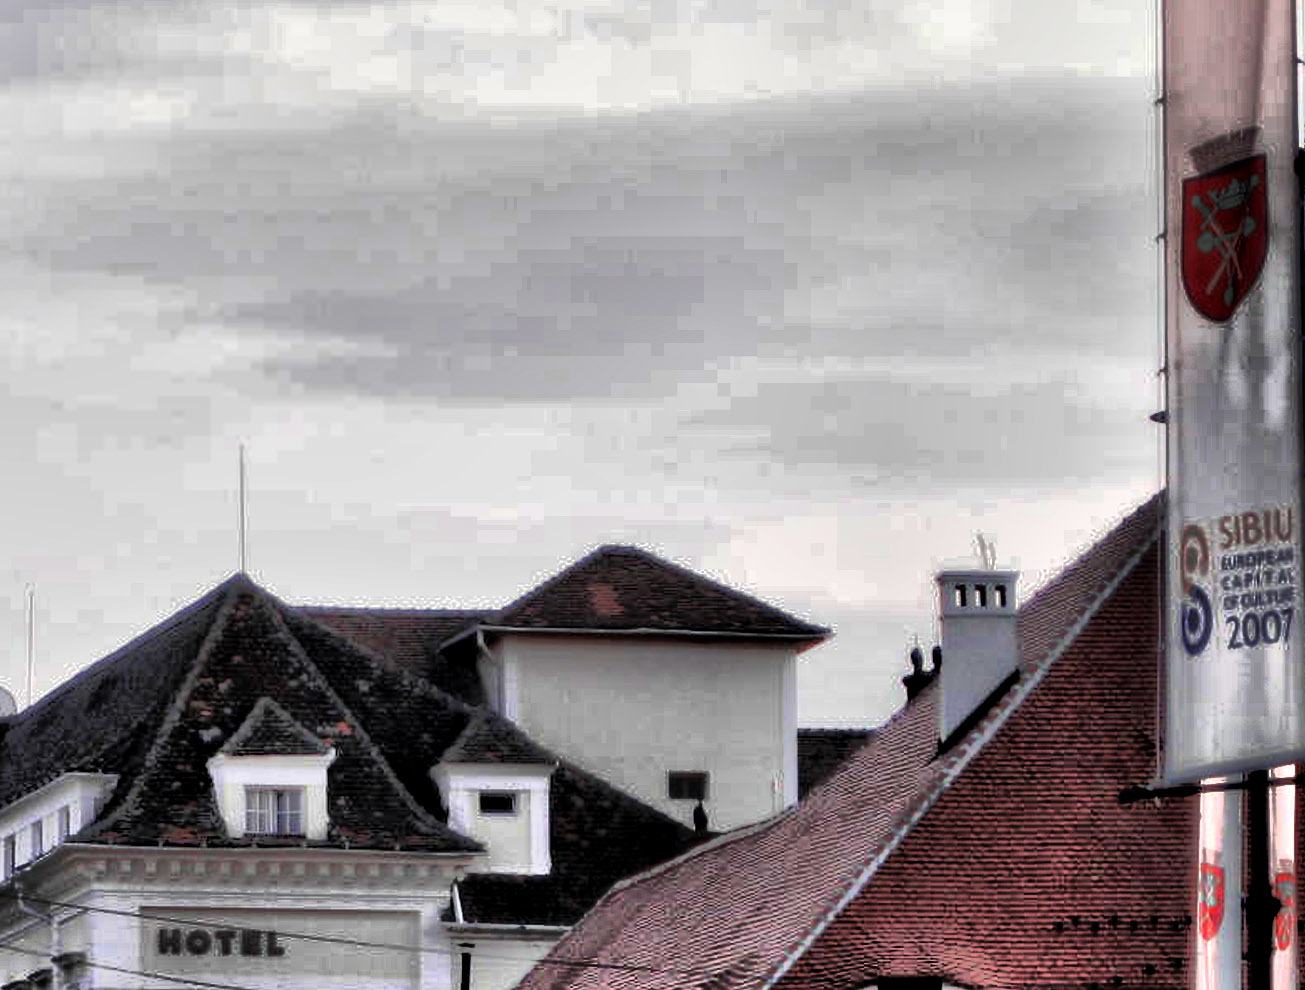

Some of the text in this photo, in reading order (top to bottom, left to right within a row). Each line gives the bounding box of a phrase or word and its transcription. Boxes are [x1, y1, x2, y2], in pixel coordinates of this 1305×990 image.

[1219, 508, 1292, 549] SIBIU
[1226, 608, 1293, 649] 2007
[158, 928, 286, 957] HOTEL
